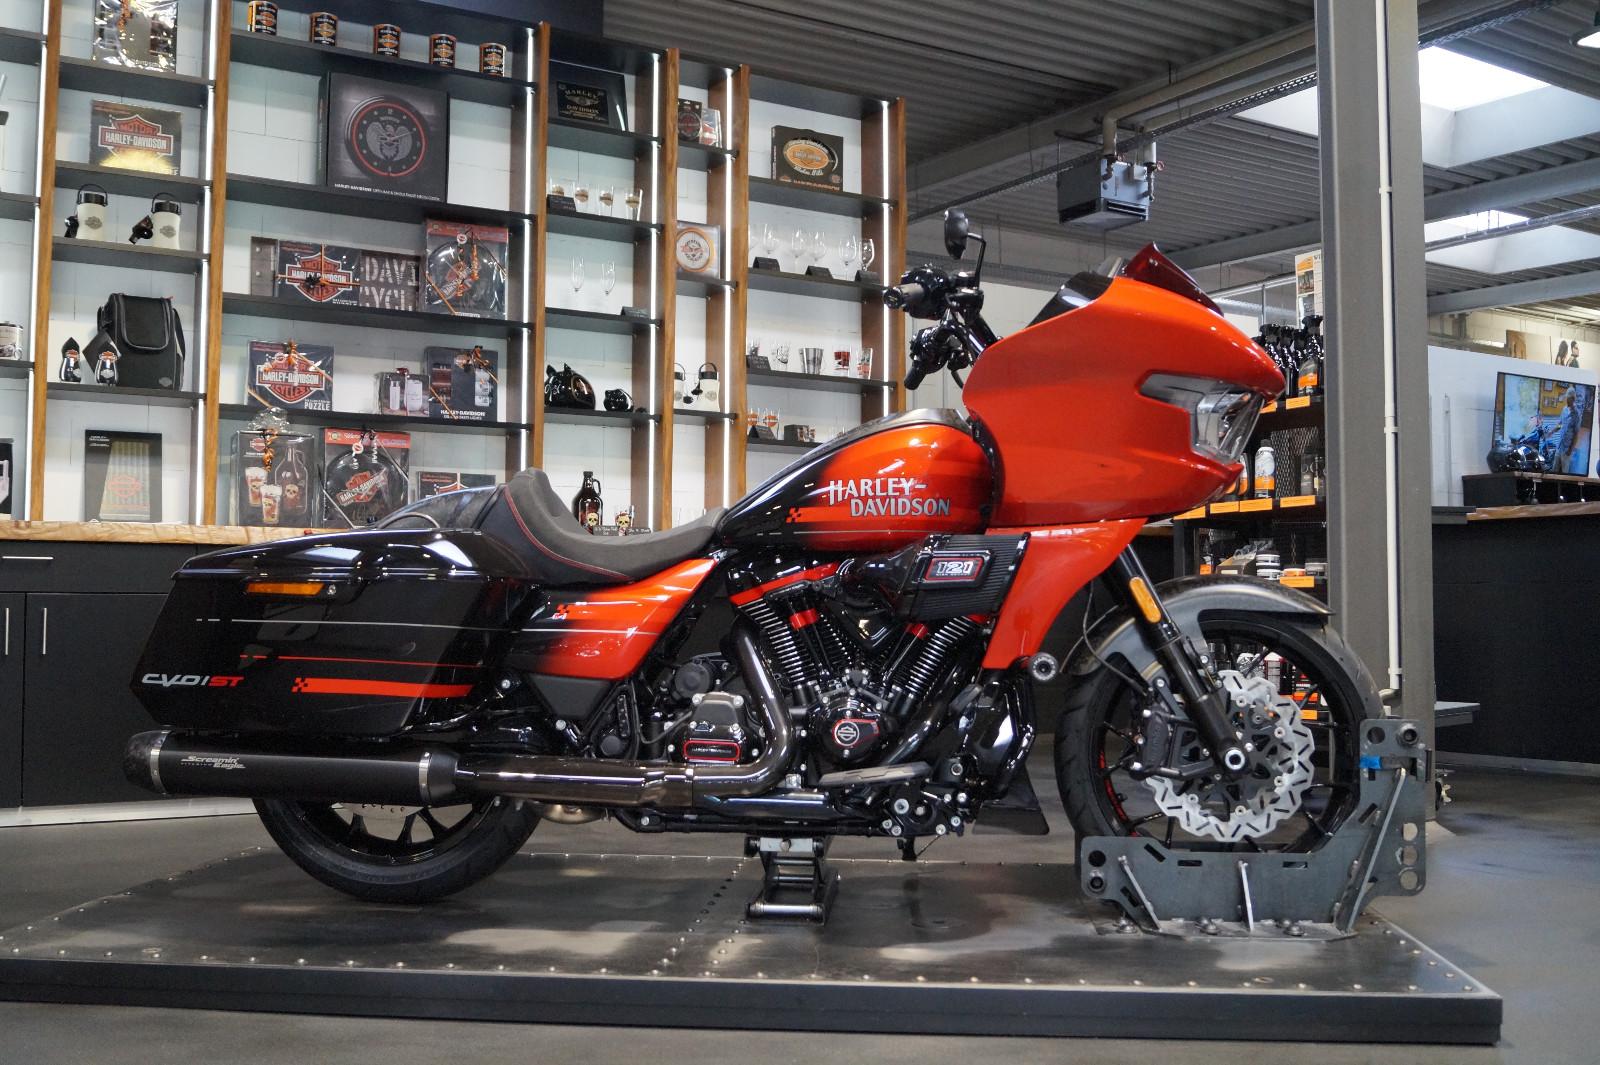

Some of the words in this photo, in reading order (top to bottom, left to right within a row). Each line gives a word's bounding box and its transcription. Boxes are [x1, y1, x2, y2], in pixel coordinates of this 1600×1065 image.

[104, 131, 168, 150] HARLEY-DAVIDSON
[304, 401, 331, 411] PUZZLE
[851, 498, 949, 516] DAVIDSON
[937, 561, 974, 574] 121
